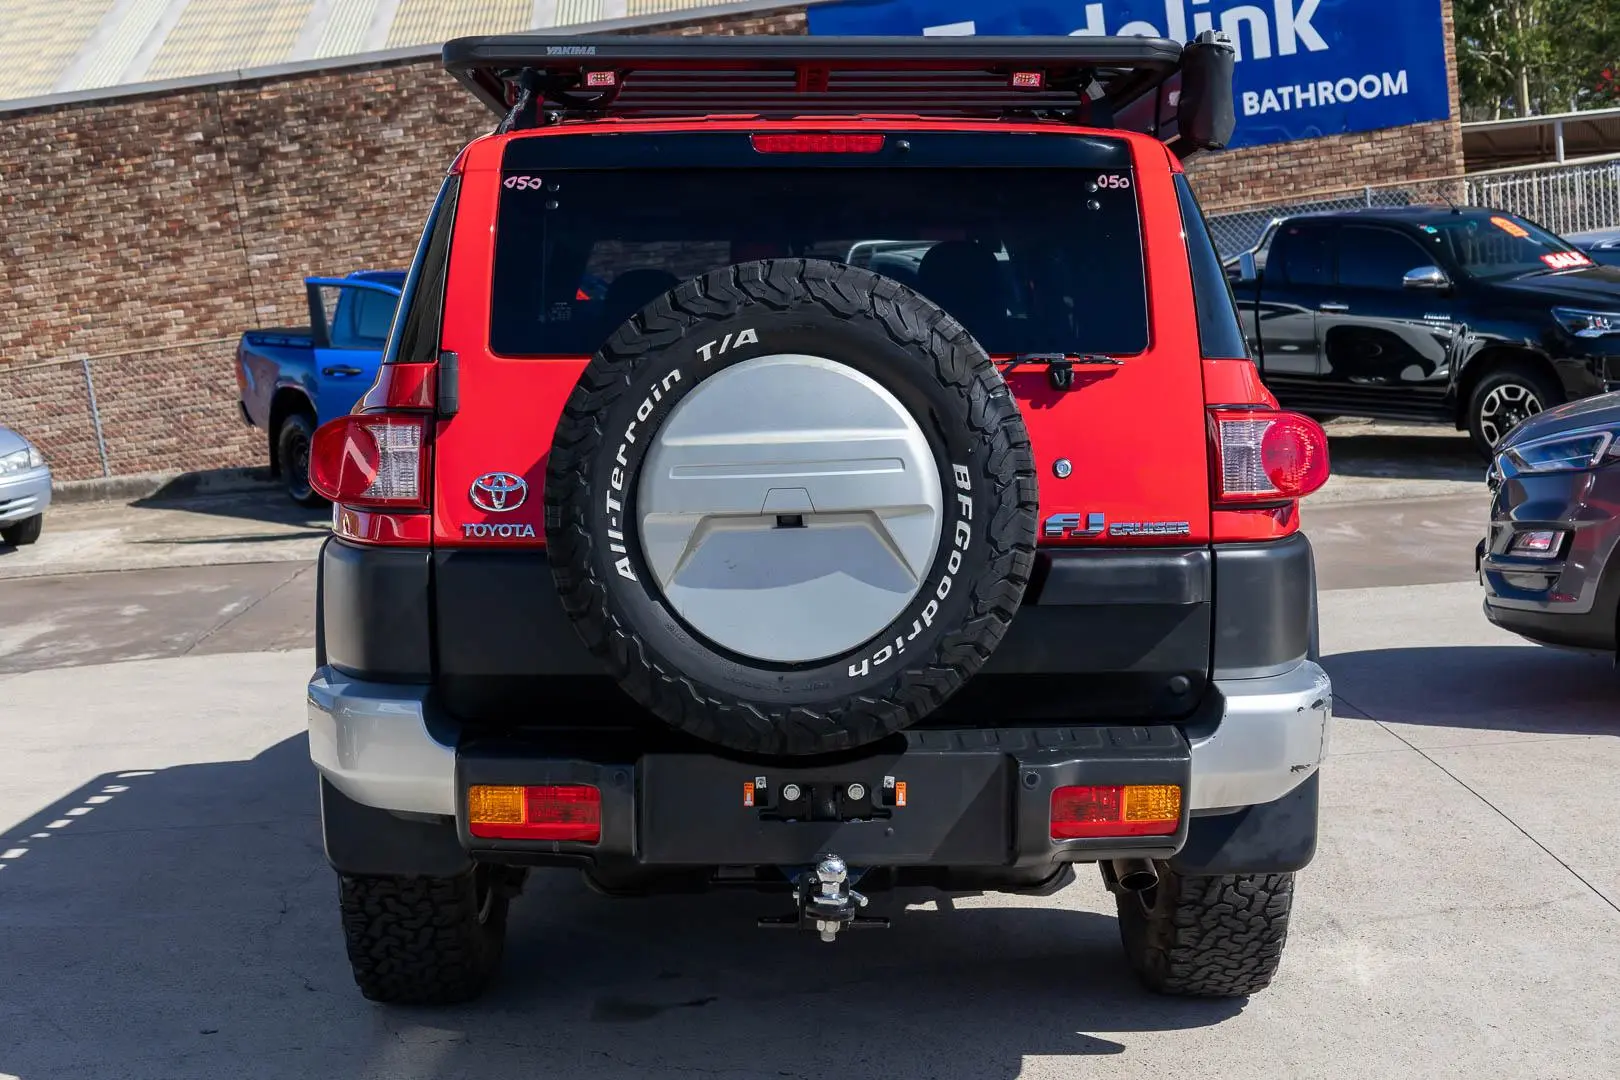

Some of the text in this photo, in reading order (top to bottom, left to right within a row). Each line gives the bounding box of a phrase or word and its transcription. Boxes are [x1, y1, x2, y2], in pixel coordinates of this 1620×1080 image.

[546, 46, 596, 56] YAKIMA
[1242, 70, 1409, 116] BATHROOM
[503, 176, 542, 190] 050
[1097, 174, 1130, 189] 050
[606, 328, 759, 582] All-Terrain T/A
[462, 523, 536, 538] TOYOTA
[1045, 512, 1191, 537] FJ CRUISER
[848, 463, 973, 678] BFGoodrich
